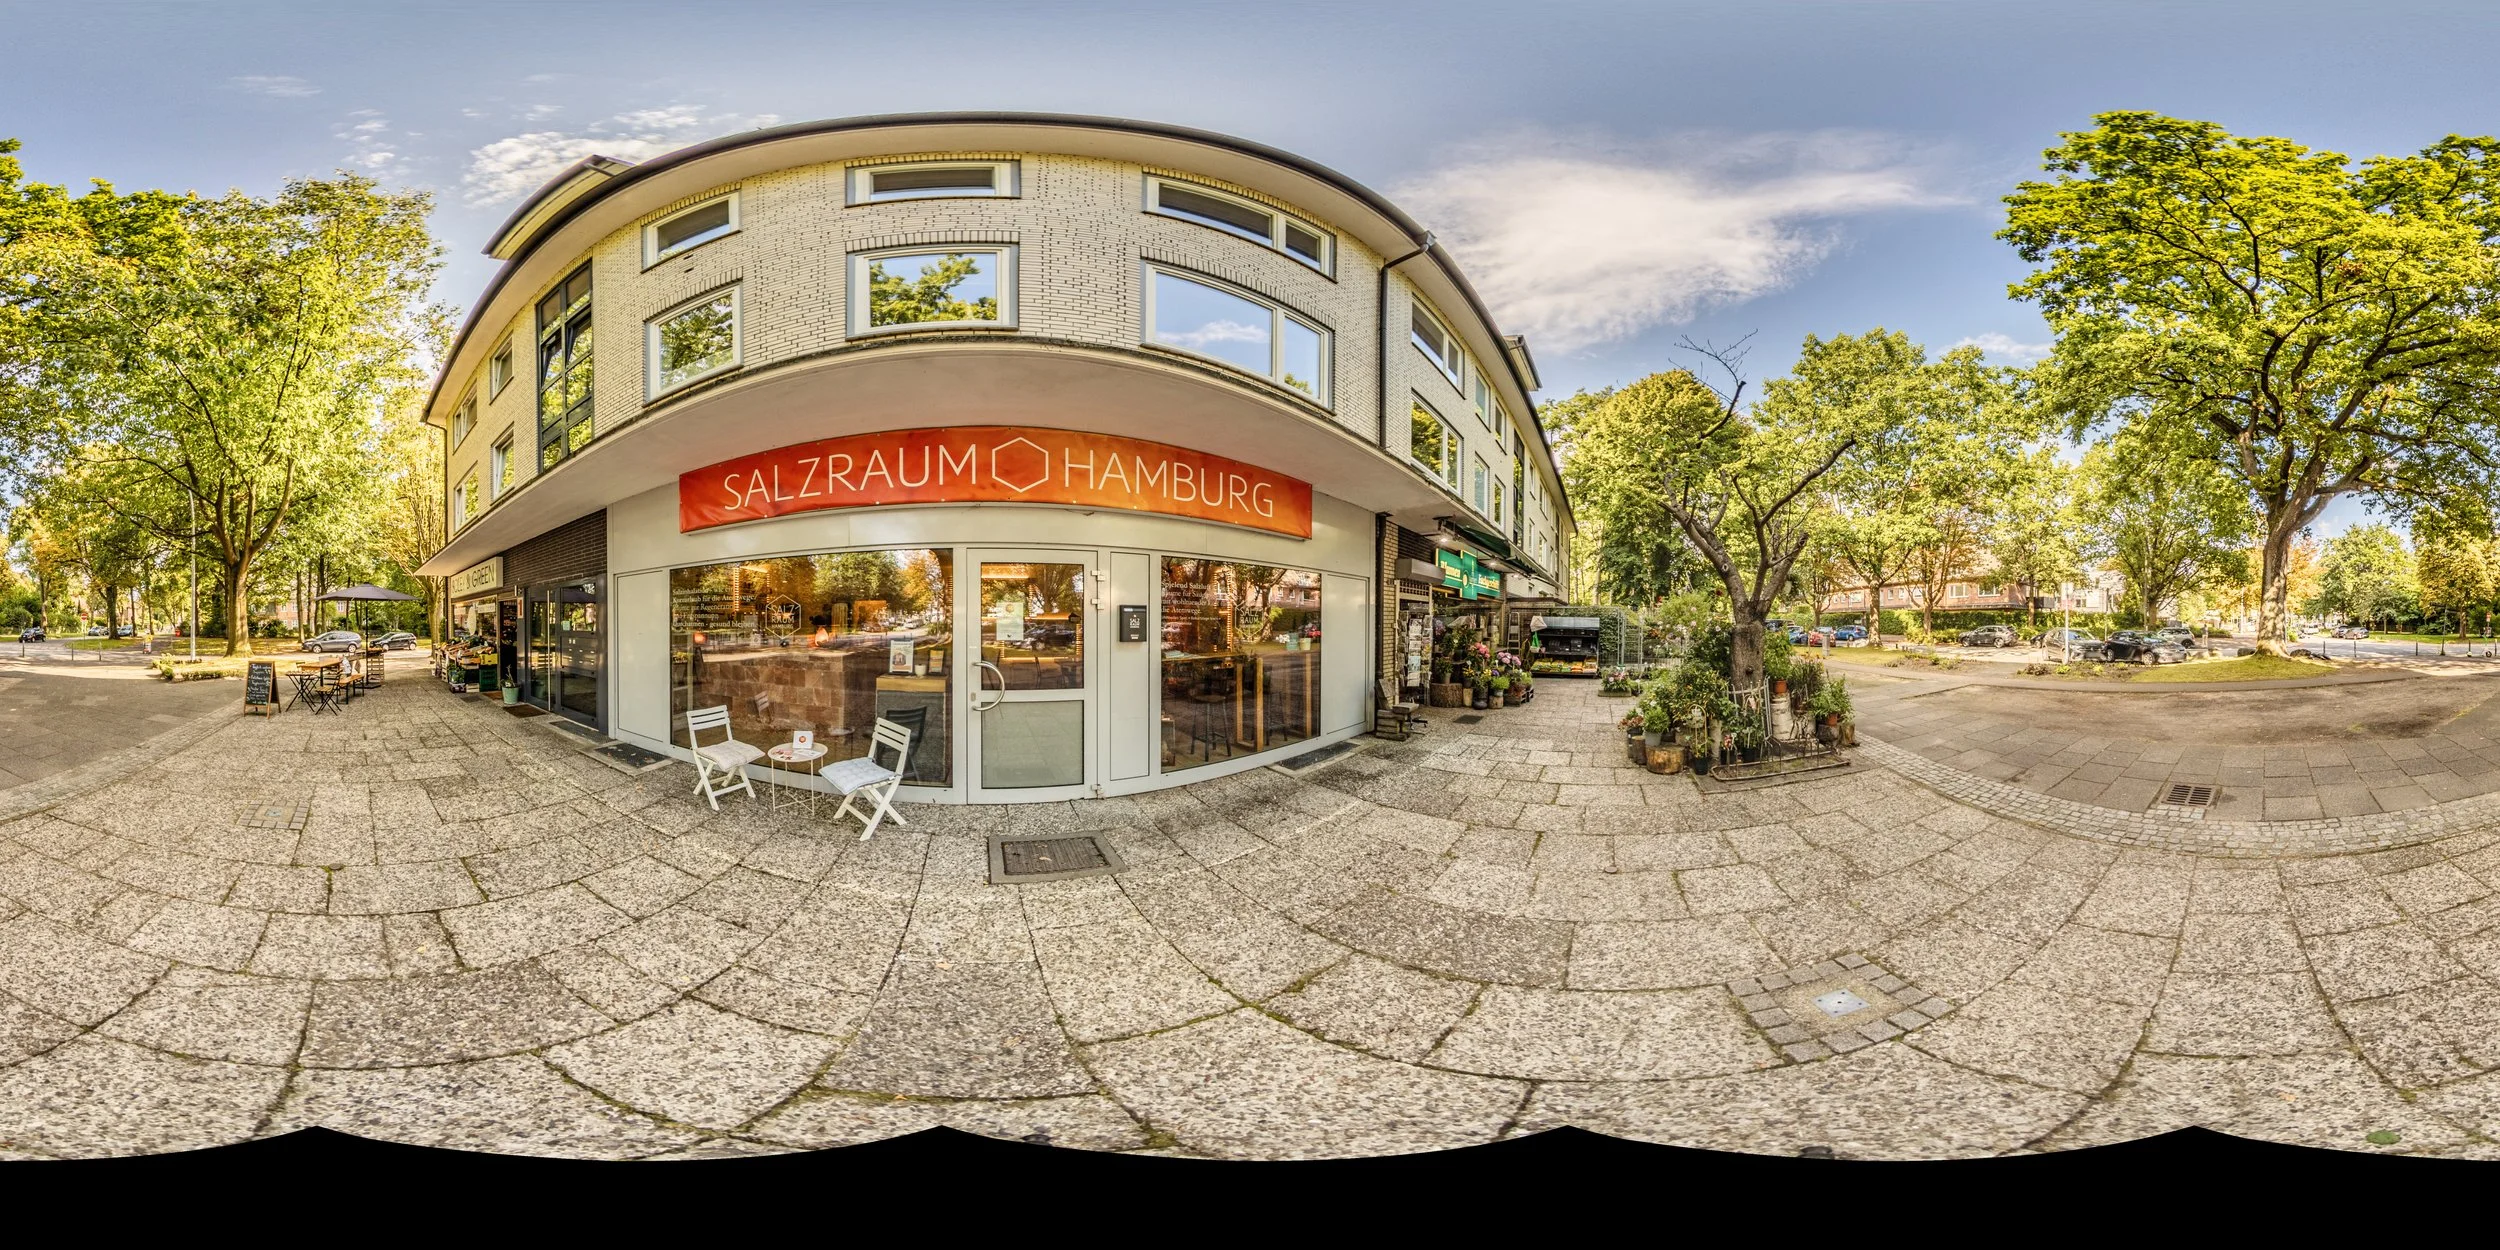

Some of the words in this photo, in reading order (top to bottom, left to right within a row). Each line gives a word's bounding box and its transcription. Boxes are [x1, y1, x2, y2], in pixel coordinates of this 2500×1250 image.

[724, 443, 976, 511] SALZRAUM
[1065, 447, 1273, 518] HAMBURG
[472, 563, 495, 587] GREEN
[1240, 607, 1260, 617] SALZ
[709, 620, 731, 629] gesund
[771, 616, 795, 624] RAUM
[1240, 616, 1260, 624] RAUM
